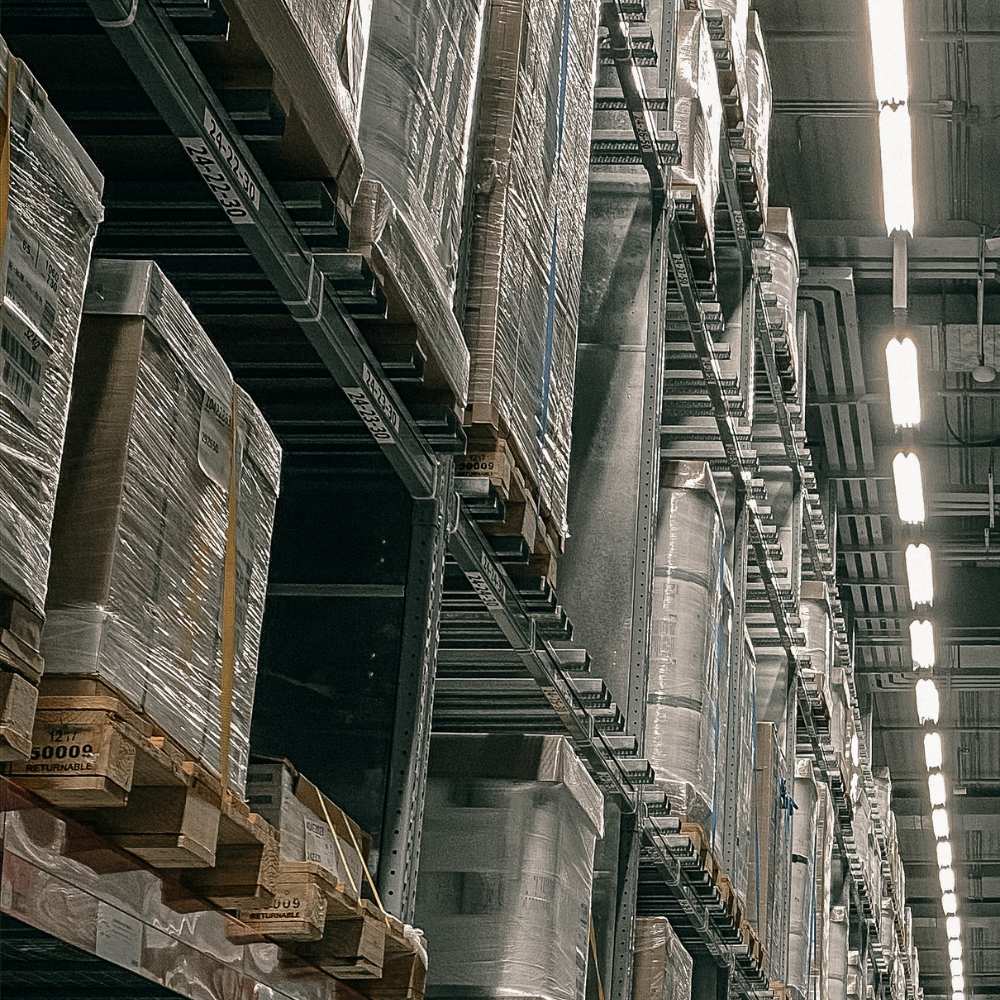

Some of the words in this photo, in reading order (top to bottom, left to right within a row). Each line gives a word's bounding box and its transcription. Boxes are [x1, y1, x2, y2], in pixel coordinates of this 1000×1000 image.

[634, 116, 651, 149] 24-26-50
[210, 119, 256, 201] 24-22-30
[185, 146, 247, 216] 24-22-30
[347, 392, 391, 439] 24-23-30
[366, 370, 397, 427] 24-23-30
[26, 763, 92, 773] RETURNABLE
[30, 744, 93, 760] 50009
[251, 912, 299, 920] RETURNABLE
